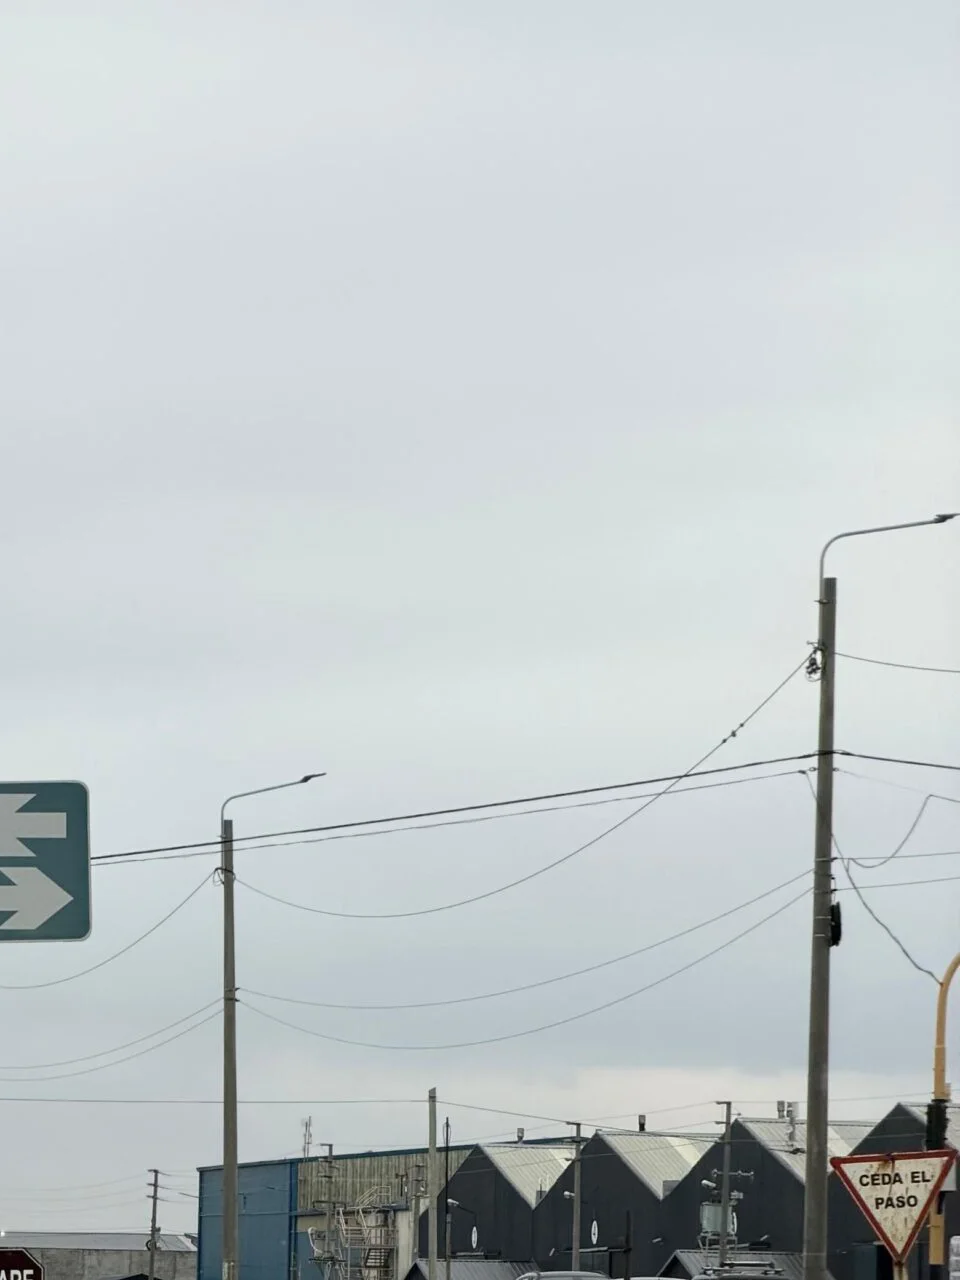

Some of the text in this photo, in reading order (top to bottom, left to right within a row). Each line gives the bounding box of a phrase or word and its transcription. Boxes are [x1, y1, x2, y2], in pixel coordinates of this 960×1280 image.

[859, 1171, 931, 1187] CEDA EL
[875, 1195, 918, 1209] PASO
